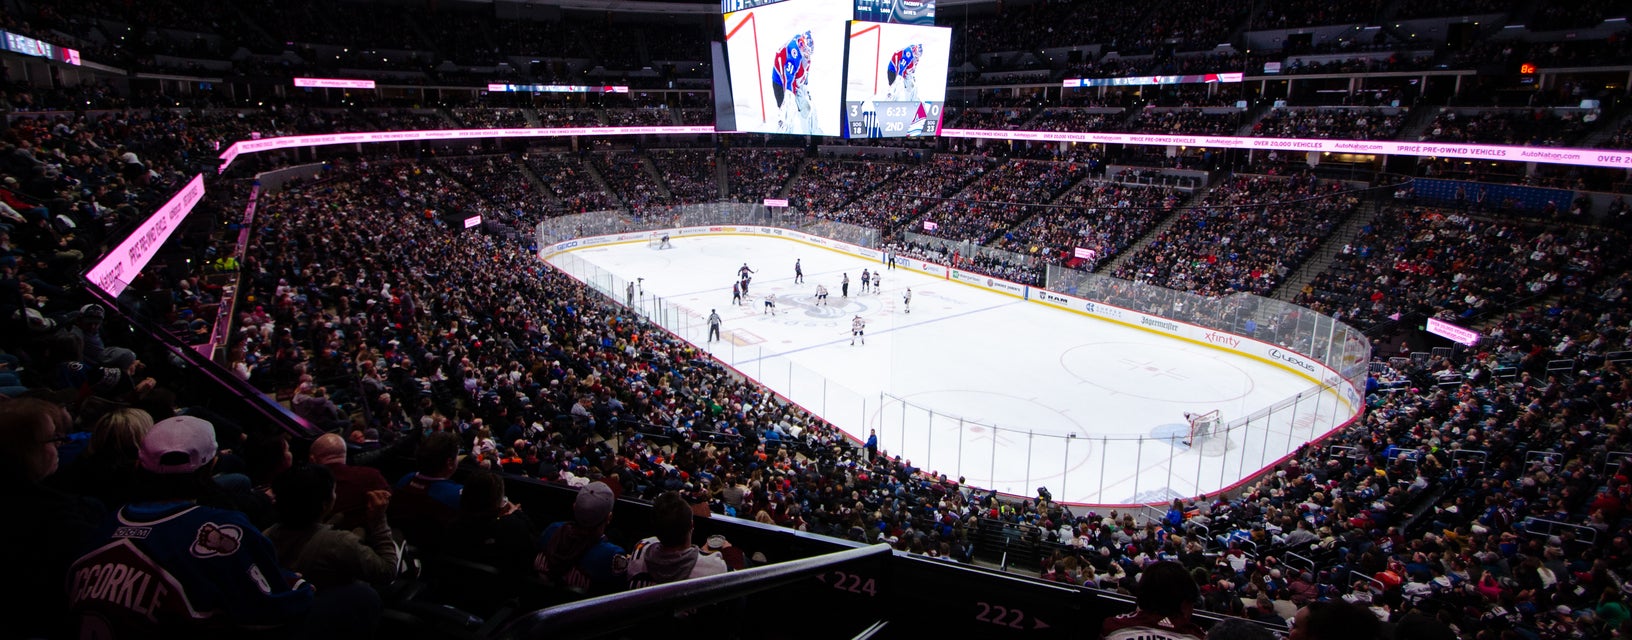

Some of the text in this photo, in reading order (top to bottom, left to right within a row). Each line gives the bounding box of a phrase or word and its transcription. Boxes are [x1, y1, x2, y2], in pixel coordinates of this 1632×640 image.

[850, 105, 858, 117] 3
[886, 107, 907, 117] 6:23
[931, 104, 939, 116] 0
[885, 121, 904, 131] 2ND
[1521, 151, 1580, 160] AutoNation.com
[1597, 155, 1622, 163] OVER
[557, 241, 578, 250] GEICO
[1204, 332, 1240, 348] xfinity
[1282, 354, 1315, 372] LEXUS
[834, 571, 877, 596] 224
[976, 602, 1024, 629] 222
